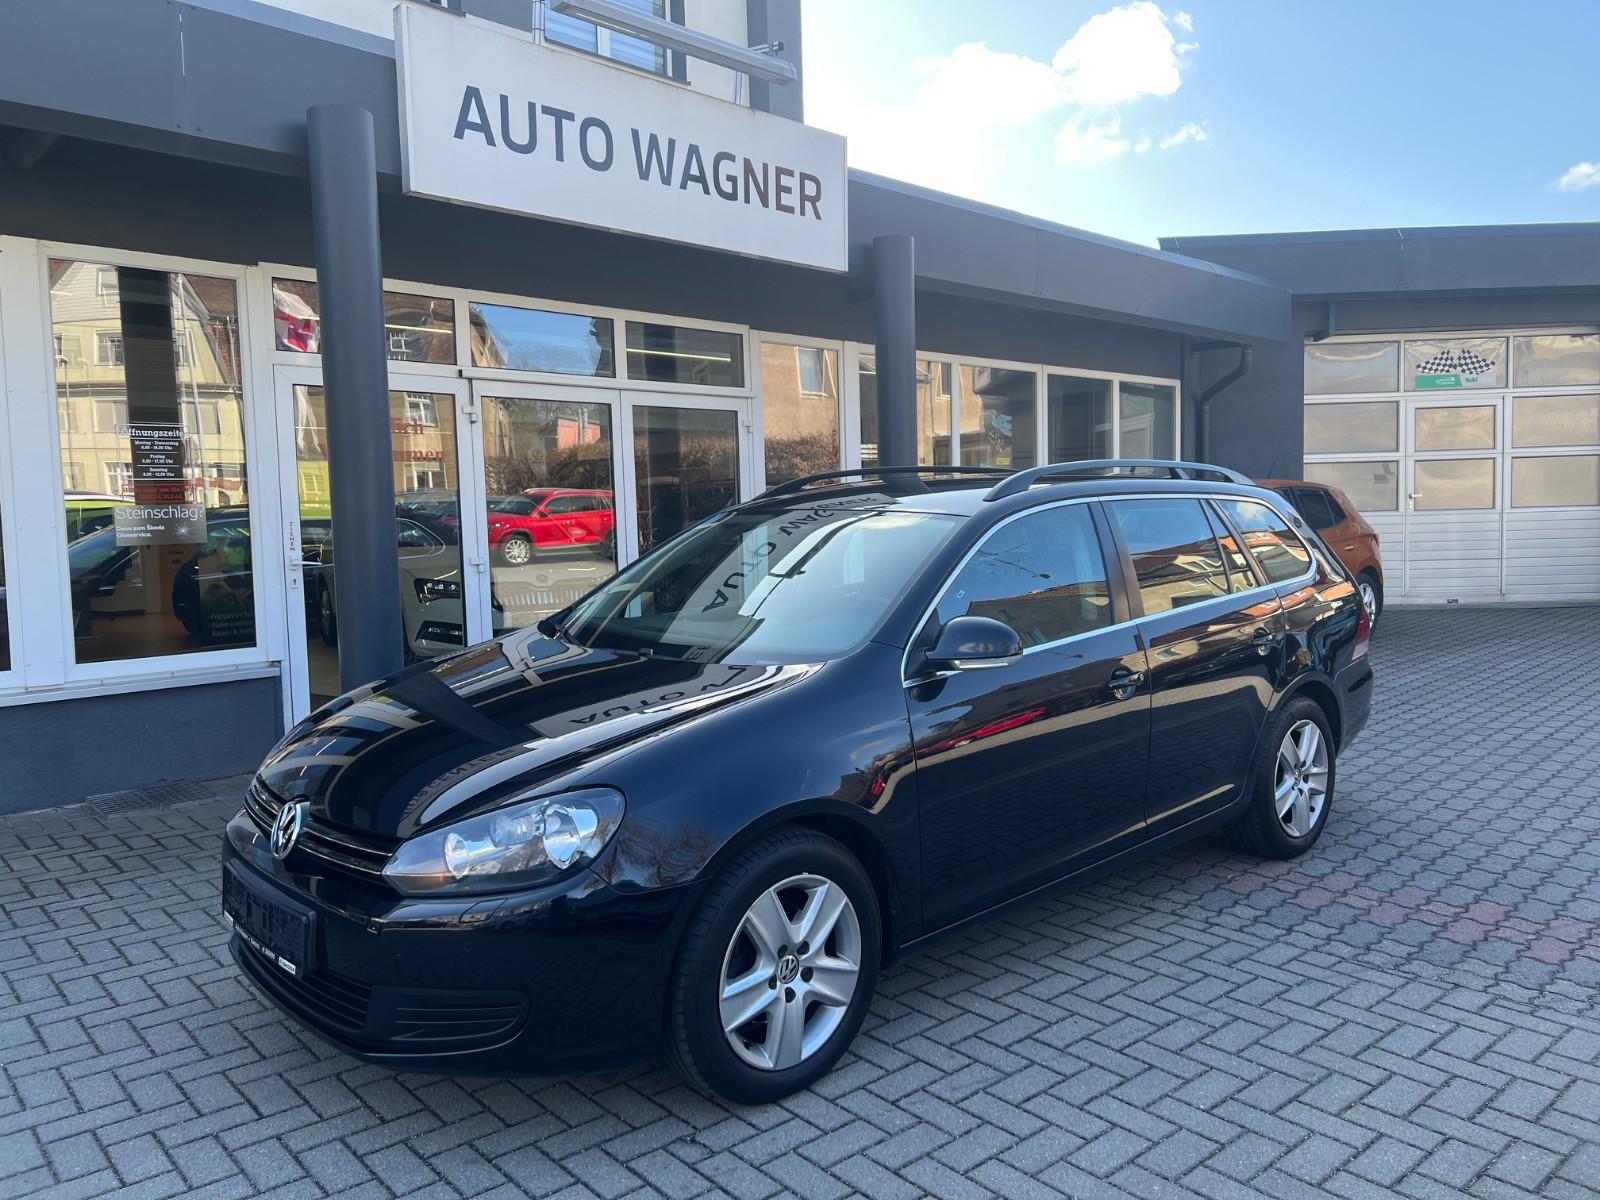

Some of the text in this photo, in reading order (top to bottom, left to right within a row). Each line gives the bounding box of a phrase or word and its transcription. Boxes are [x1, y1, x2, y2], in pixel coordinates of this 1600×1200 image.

[453, 84, 823, 222] AUTO WAGNER
[115, 505, 204, 521] Steinschlag?
